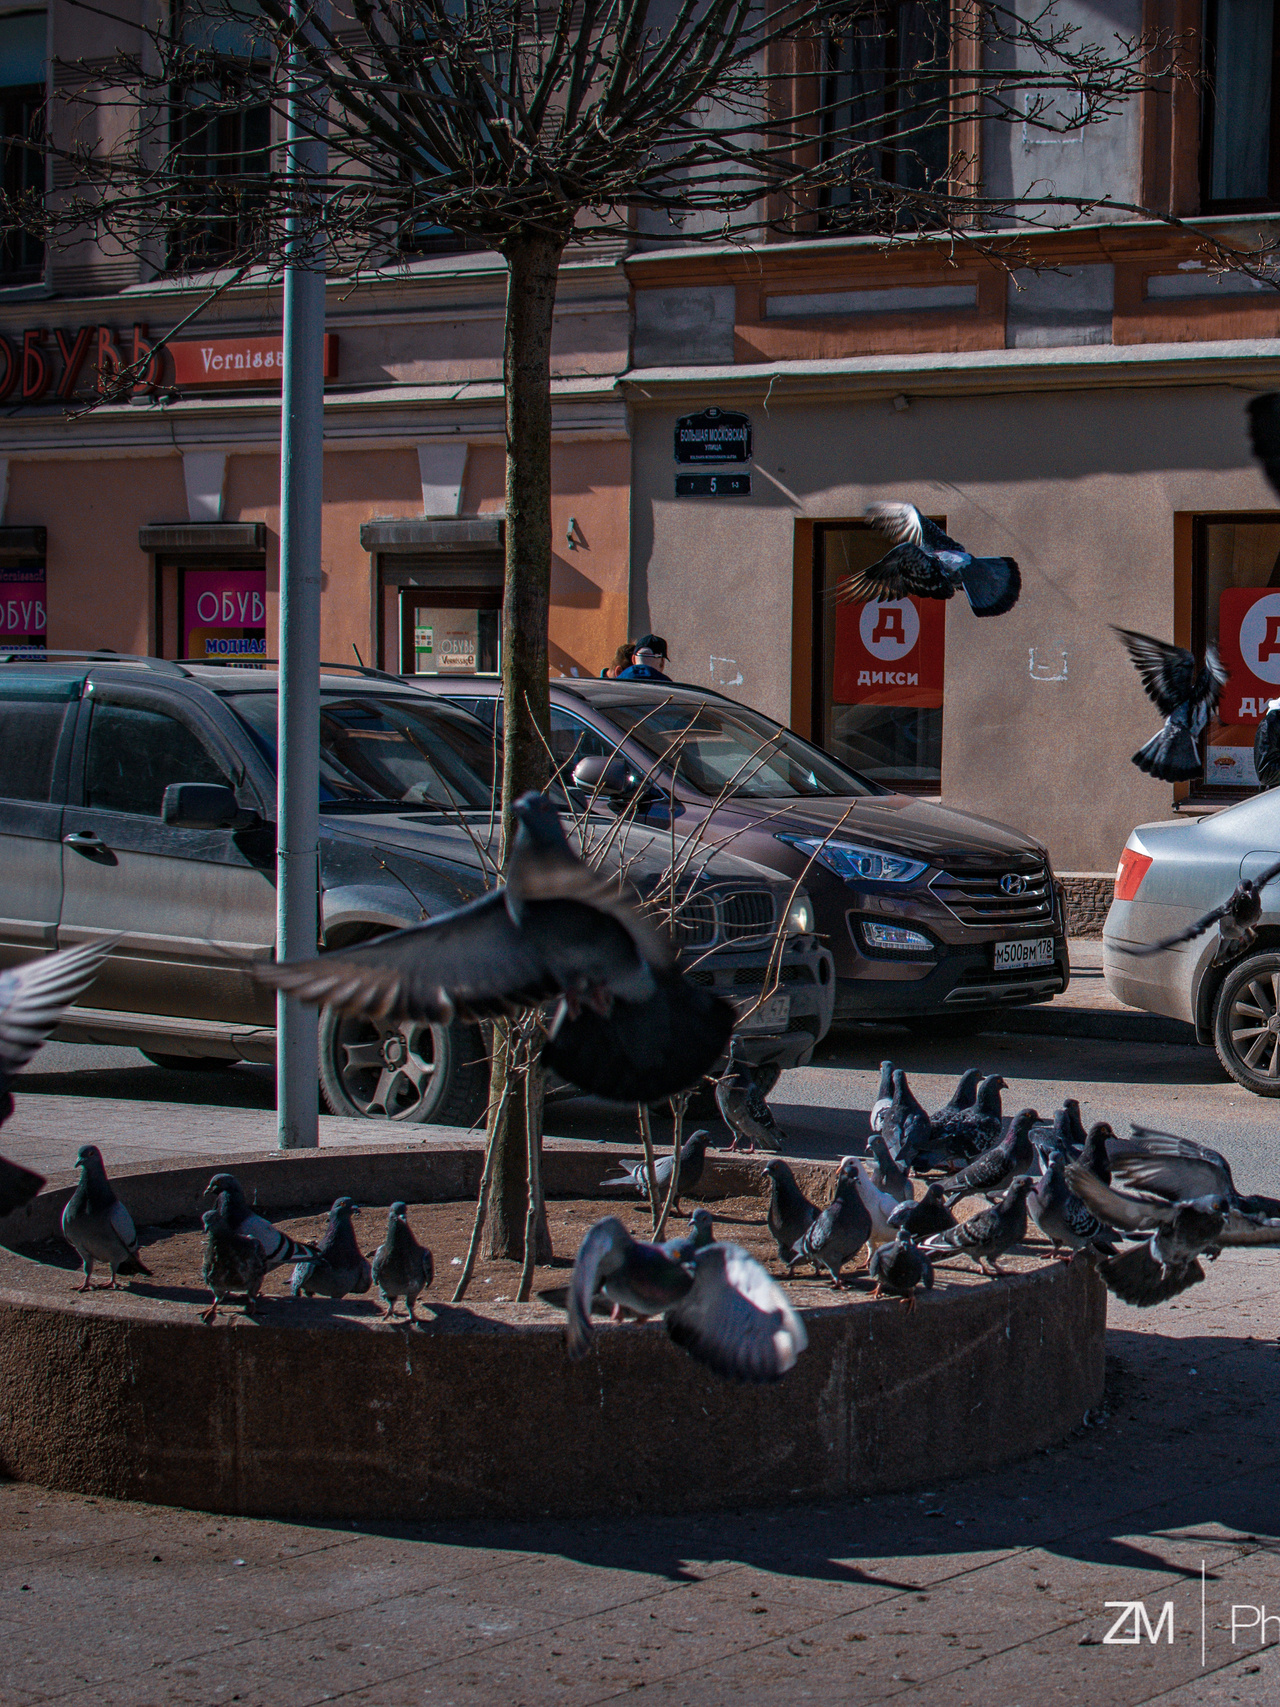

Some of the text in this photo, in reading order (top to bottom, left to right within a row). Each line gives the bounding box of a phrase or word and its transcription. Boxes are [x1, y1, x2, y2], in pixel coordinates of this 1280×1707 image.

[681, 427, 748, 442] БОЛЬШАЯ МОСКОВСКАЯ
[704, 443, 722, 451] УЛИЦА
[710, 477, 717, 492] 5
[0, 600, 46, 630] БУВ
[872, 608, 905, 644] Д
[205, 638, 266, 655] МОДНАЯ
[996, 944, 1037, 963] М500ВМ
